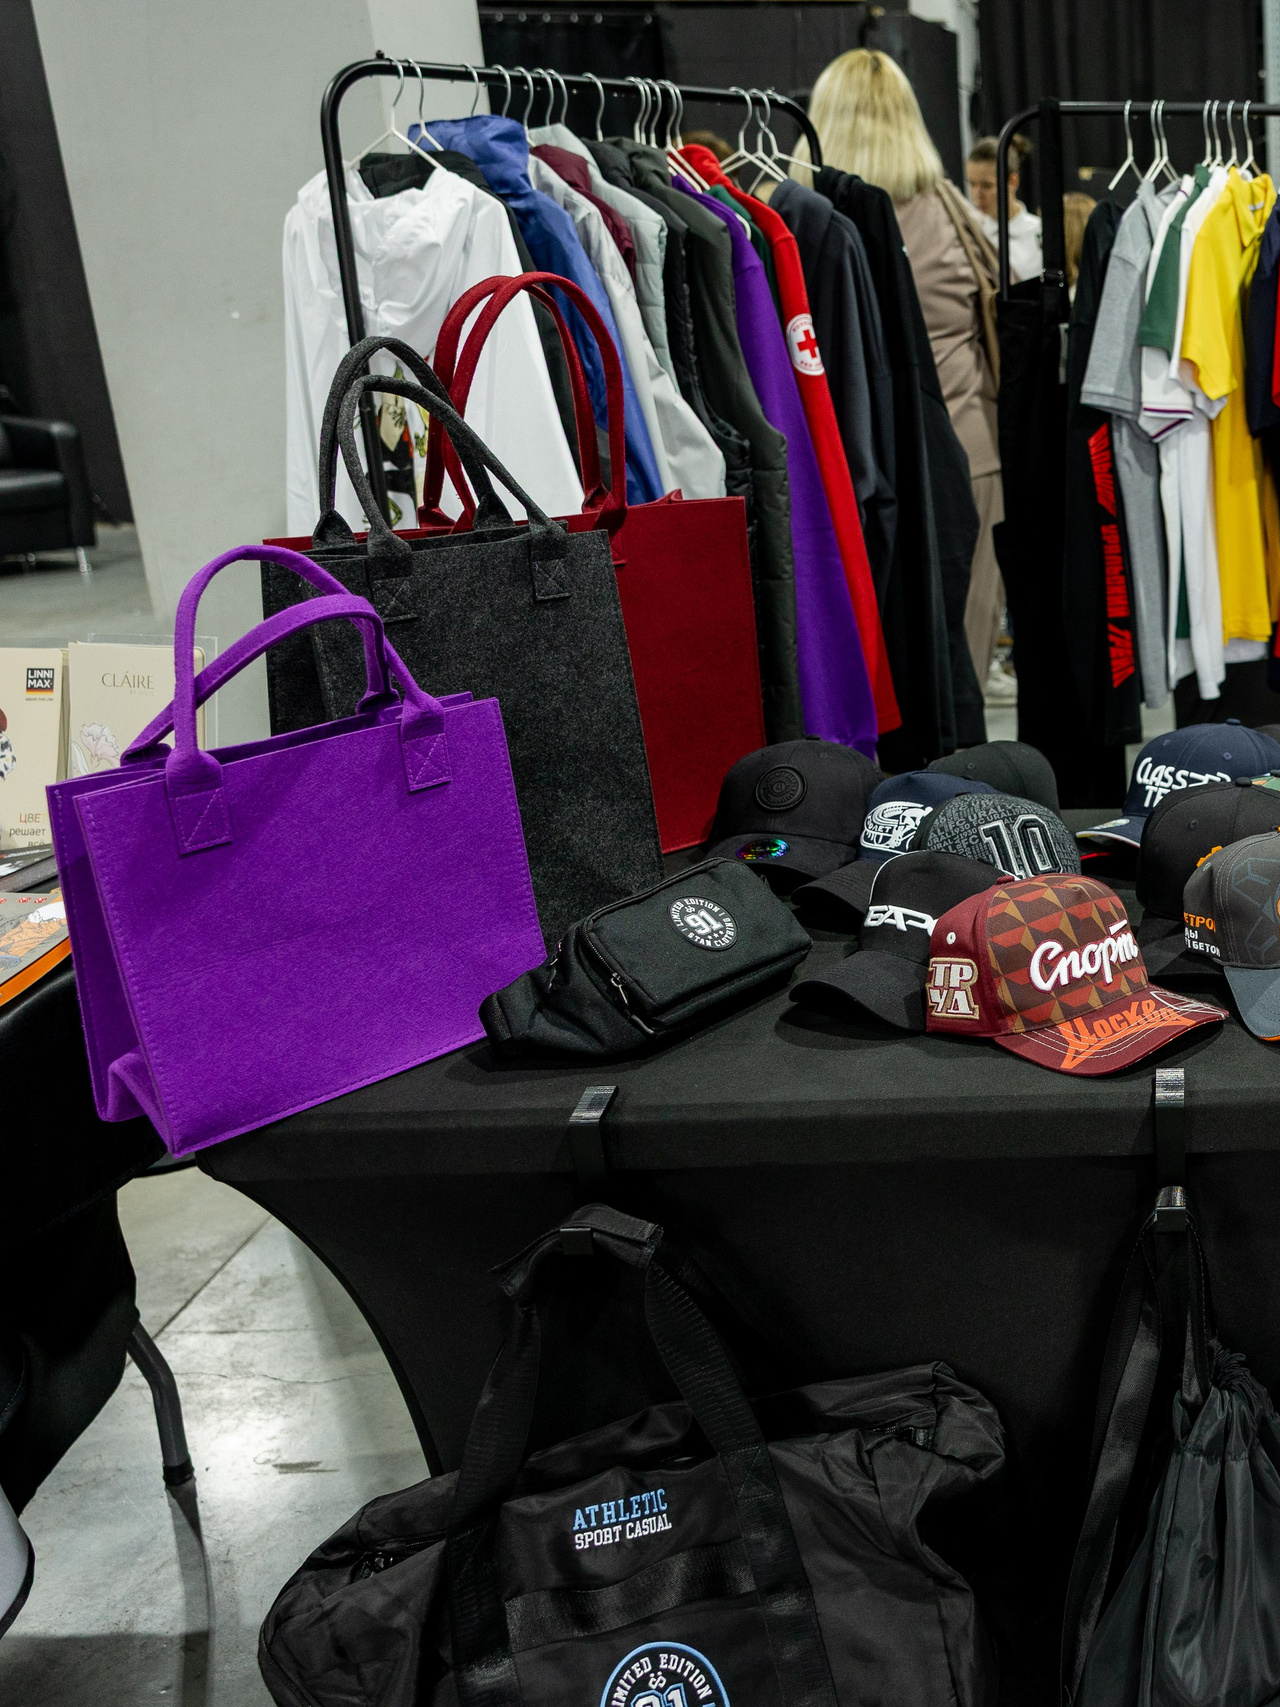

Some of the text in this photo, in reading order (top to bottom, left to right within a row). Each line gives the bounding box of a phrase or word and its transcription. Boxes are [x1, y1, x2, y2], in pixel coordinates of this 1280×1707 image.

[27, 679, 51, 688] MAX
[28, 669, 53, 679] LINNI
[9, 828, 46, 838] решает
[978, 814, 1063, 879] 10
[671, 898, 720, 927] LIMITED EDITION
[684, 908, 724, 936] 91
[688, 932, 712, 947] STAN
[1029, 919, 1139, 992] Спорт
[573, 1488, 668, 1531] ATHLETIC
[575, 1513, 672, 1550] SPORT CASUAL
[611, 1656, 652, 1707] IMITED
[659, 1653, 713, 1700] EDITION
